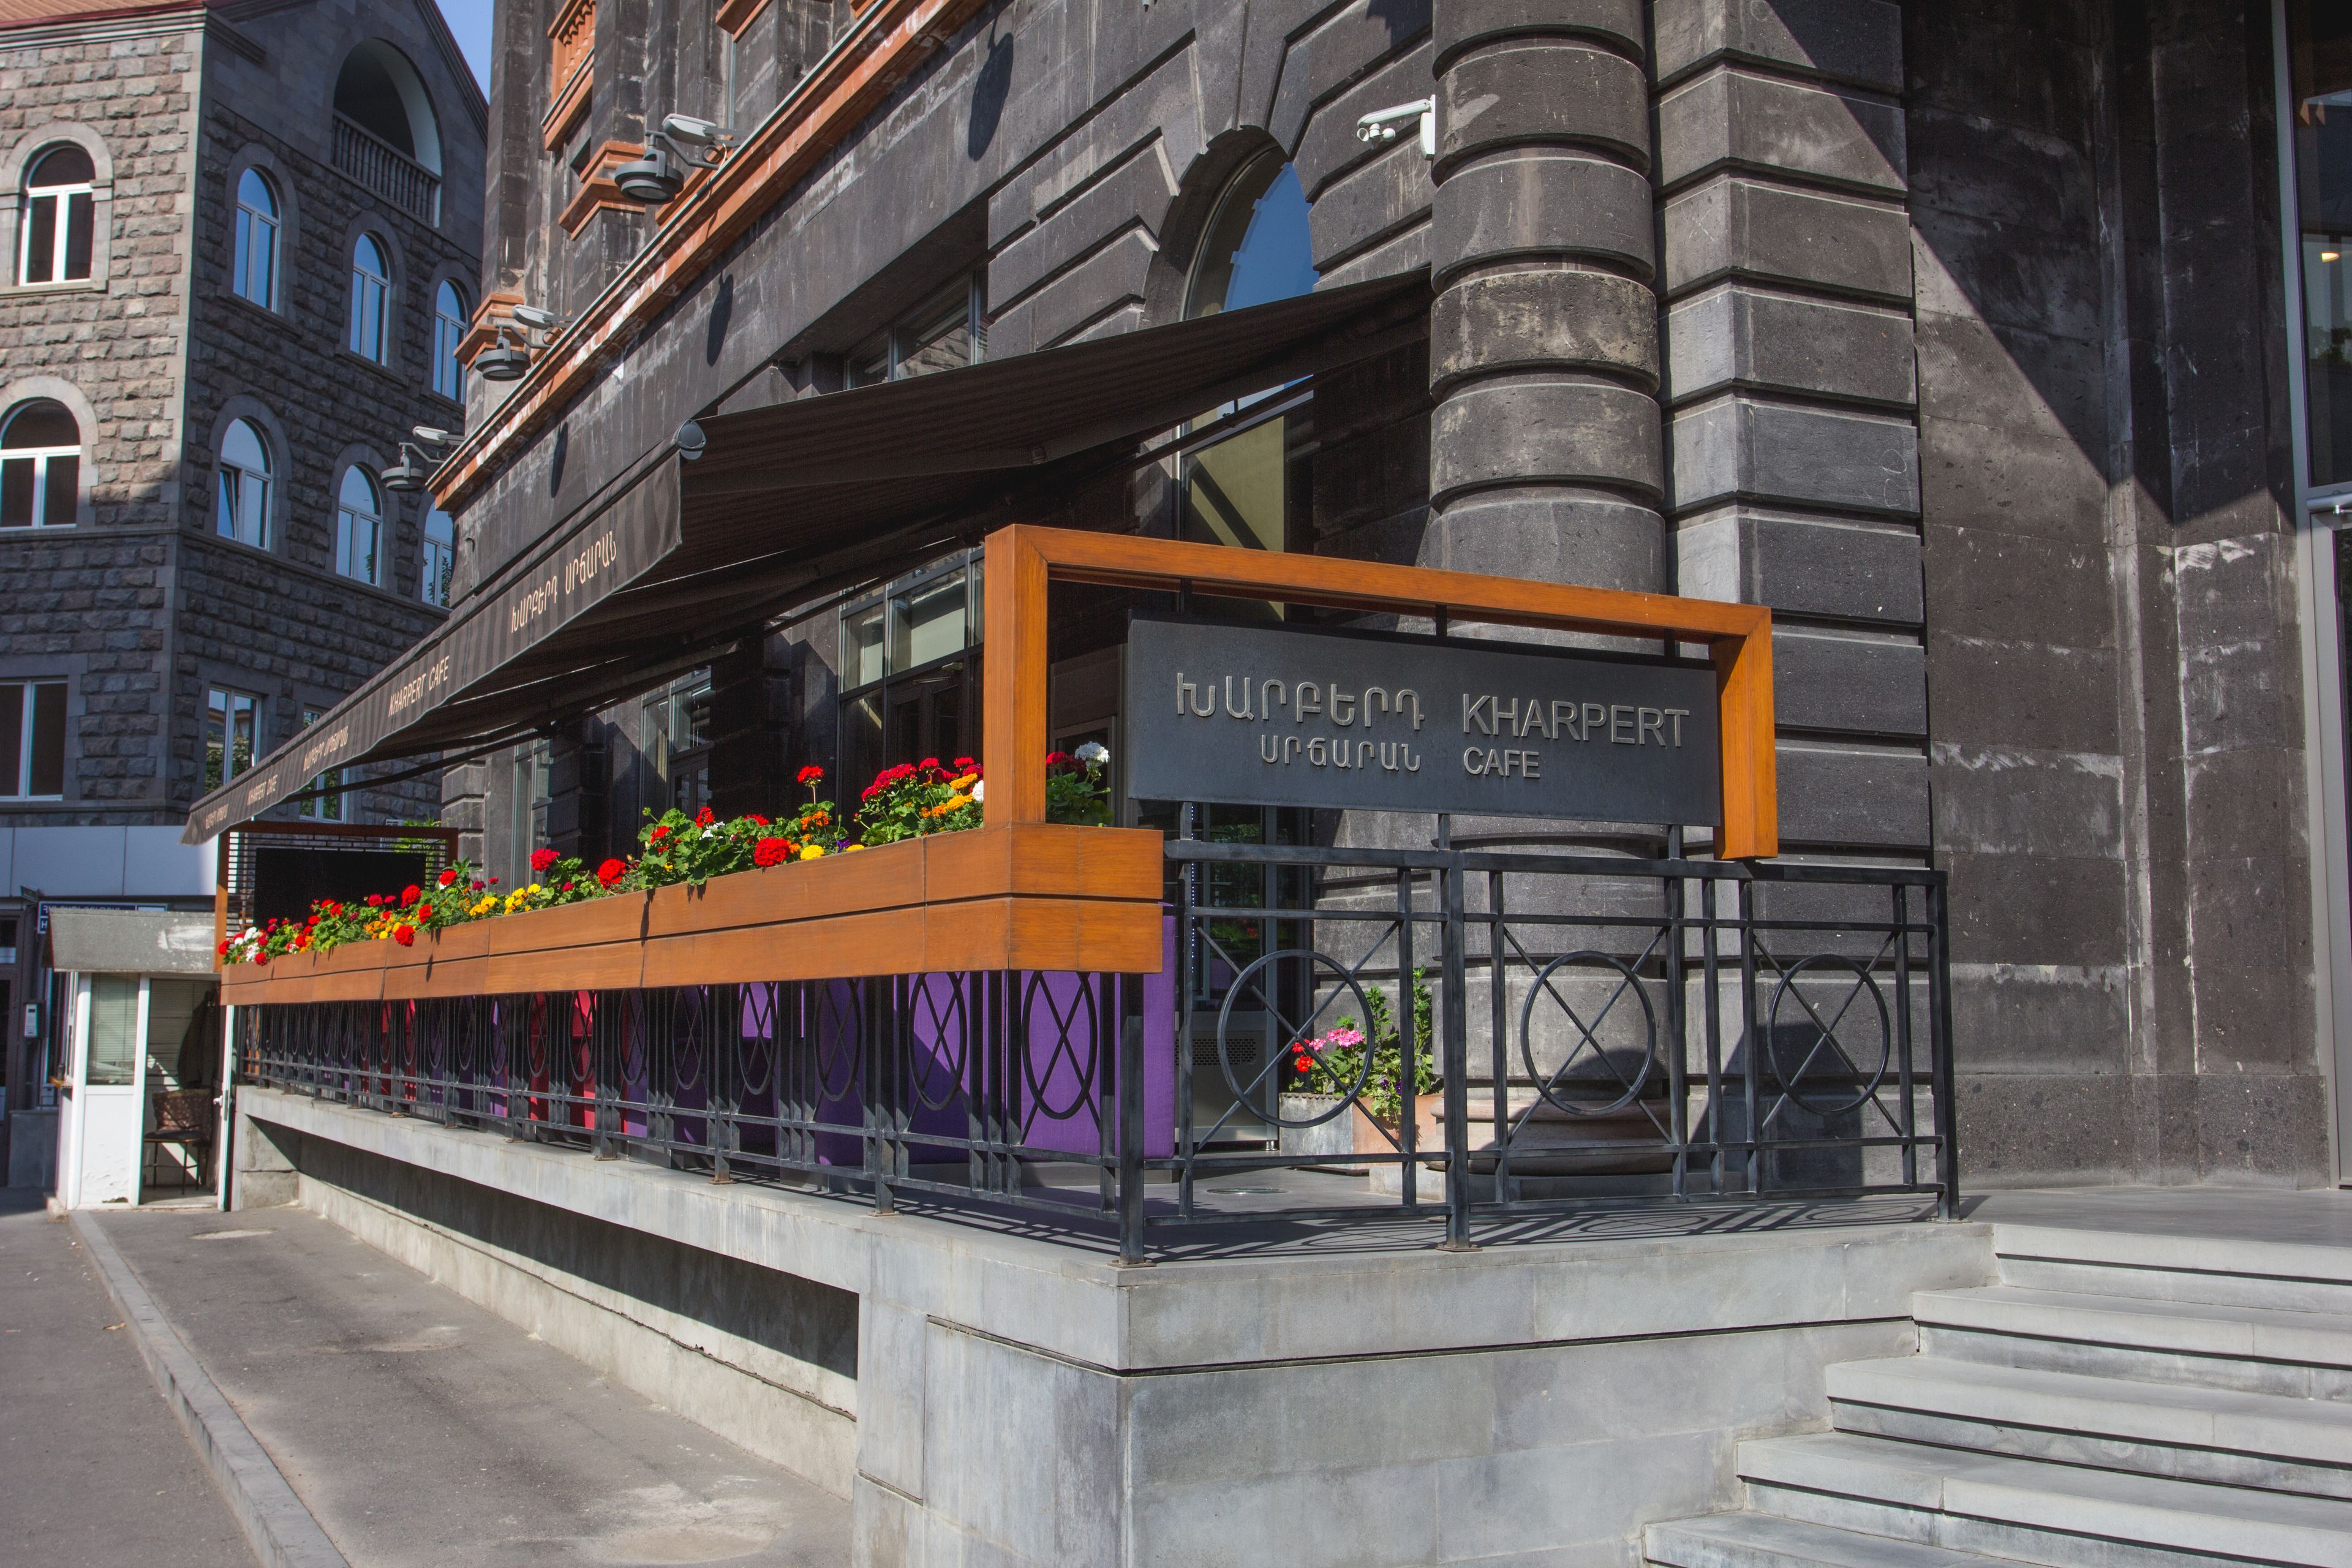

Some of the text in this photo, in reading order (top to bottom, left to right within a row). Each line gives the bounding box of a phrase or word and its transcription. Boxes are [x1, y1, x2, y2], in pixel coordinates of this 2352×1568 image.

[511, 530, 617, 633] ԽԱՐԲԵՐԴ ՍՐՃԱՐԱՆ
[388, 655, 450, 717] KHARPERT CAFE
[1177, 672, 1425, 731] ԽԱՐԲԵՐԴ
[1463, 693, 1690, 747] KHARPERT
[1261, 734, 1422, 772] ՍՐՃԱՐԱՆ
[1463, 746, 1541, 778] CAFE
